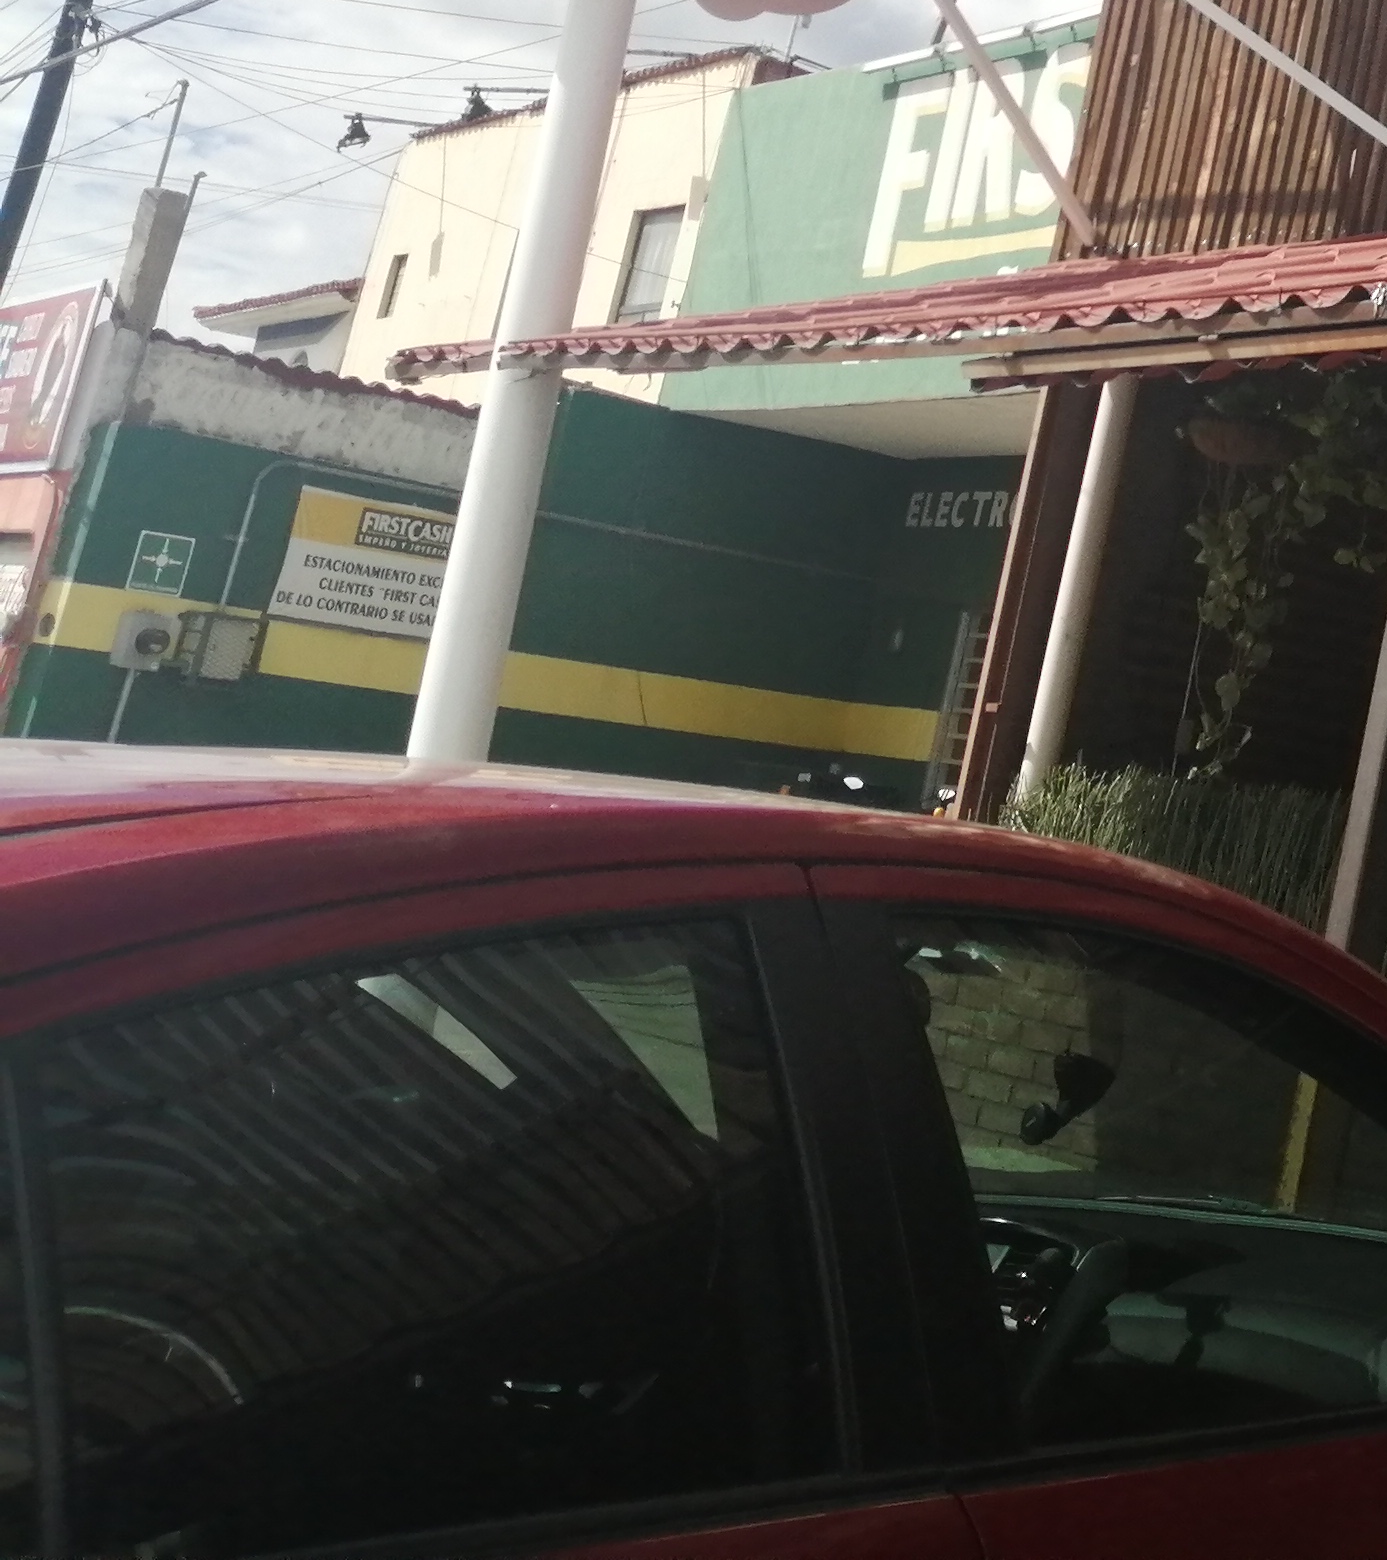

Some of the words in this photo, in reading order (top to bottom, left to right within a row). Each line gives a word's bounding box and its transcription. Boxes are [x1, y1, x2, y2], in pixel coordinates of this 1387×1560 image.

[304, 554, 416, 586] ESTACIONAMIENTO
[318, 577, 375, 598] CLIENTES
[276, 590, 293, 605] DE
[296, 594, 313, 608] LO
[316, 597, 389, 620] CONTRARIO
[391, 609, 405, 622] SE
